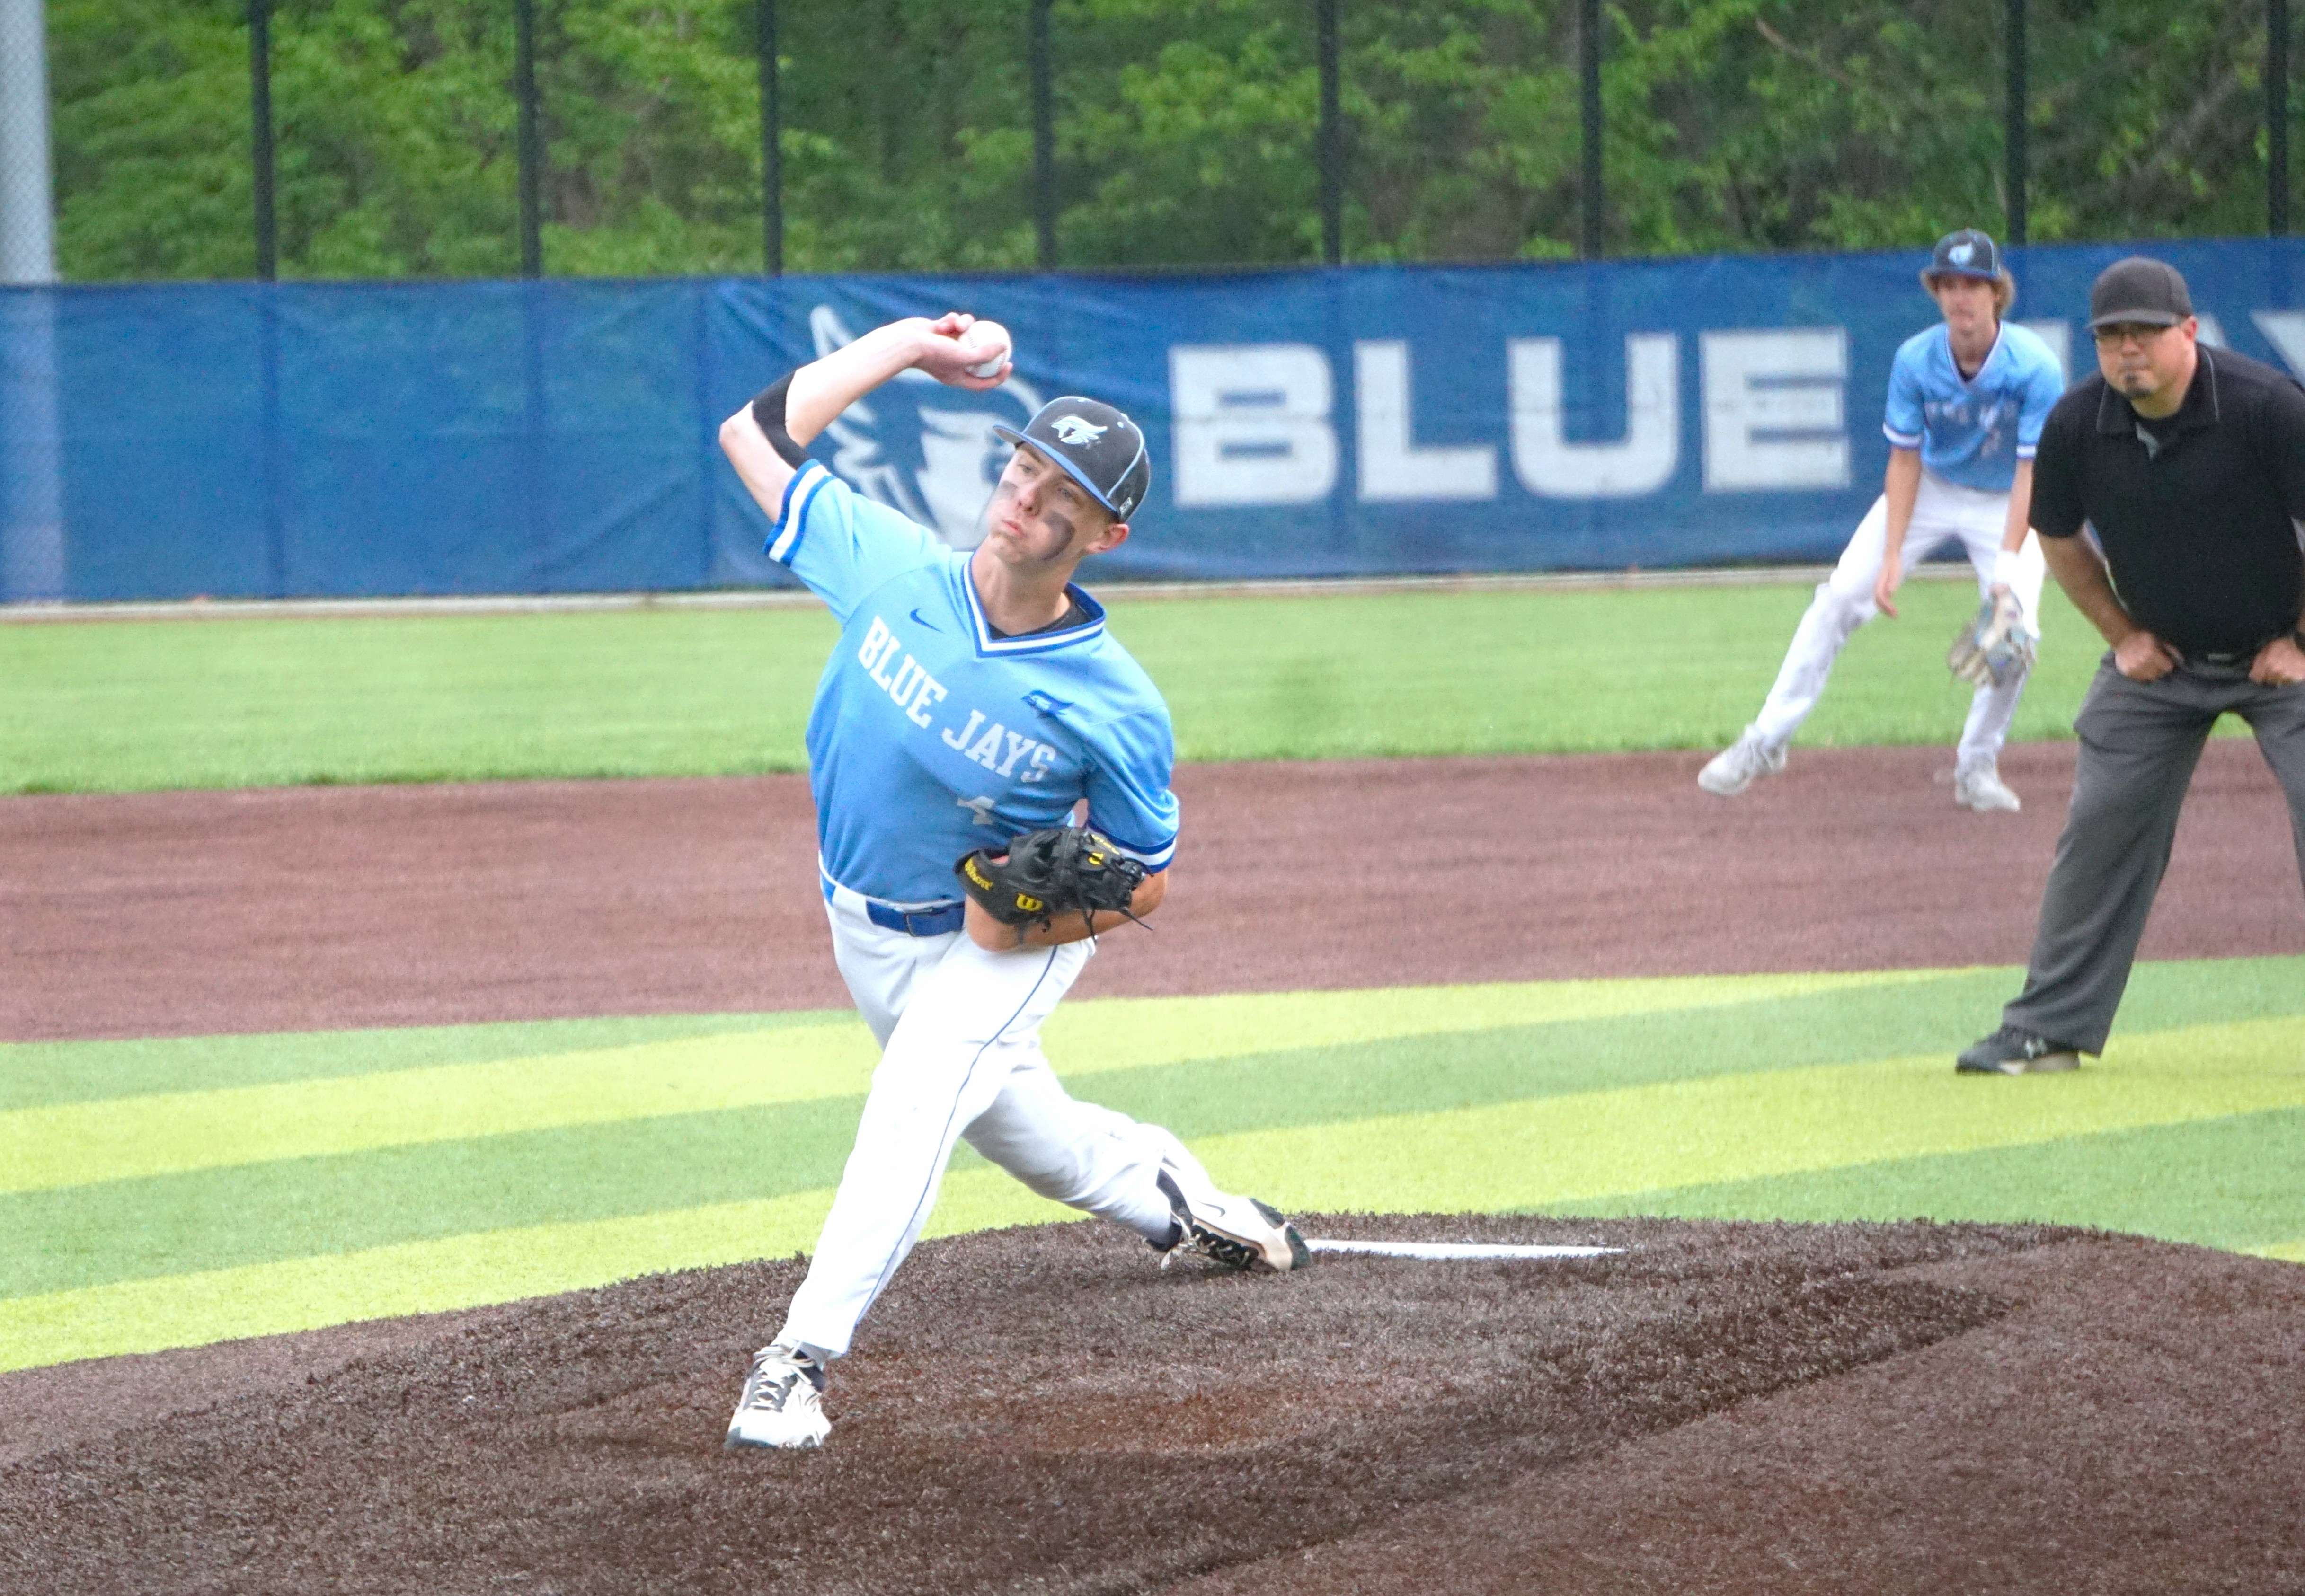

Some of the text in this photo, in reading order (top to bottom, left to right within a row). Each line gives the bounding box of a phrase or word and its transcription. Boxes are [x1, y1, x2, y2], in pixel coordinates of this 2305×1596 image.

[1169, 326, 1851, 509] BLUE
[857, 614, 1056, 782] BLUE JAYS
